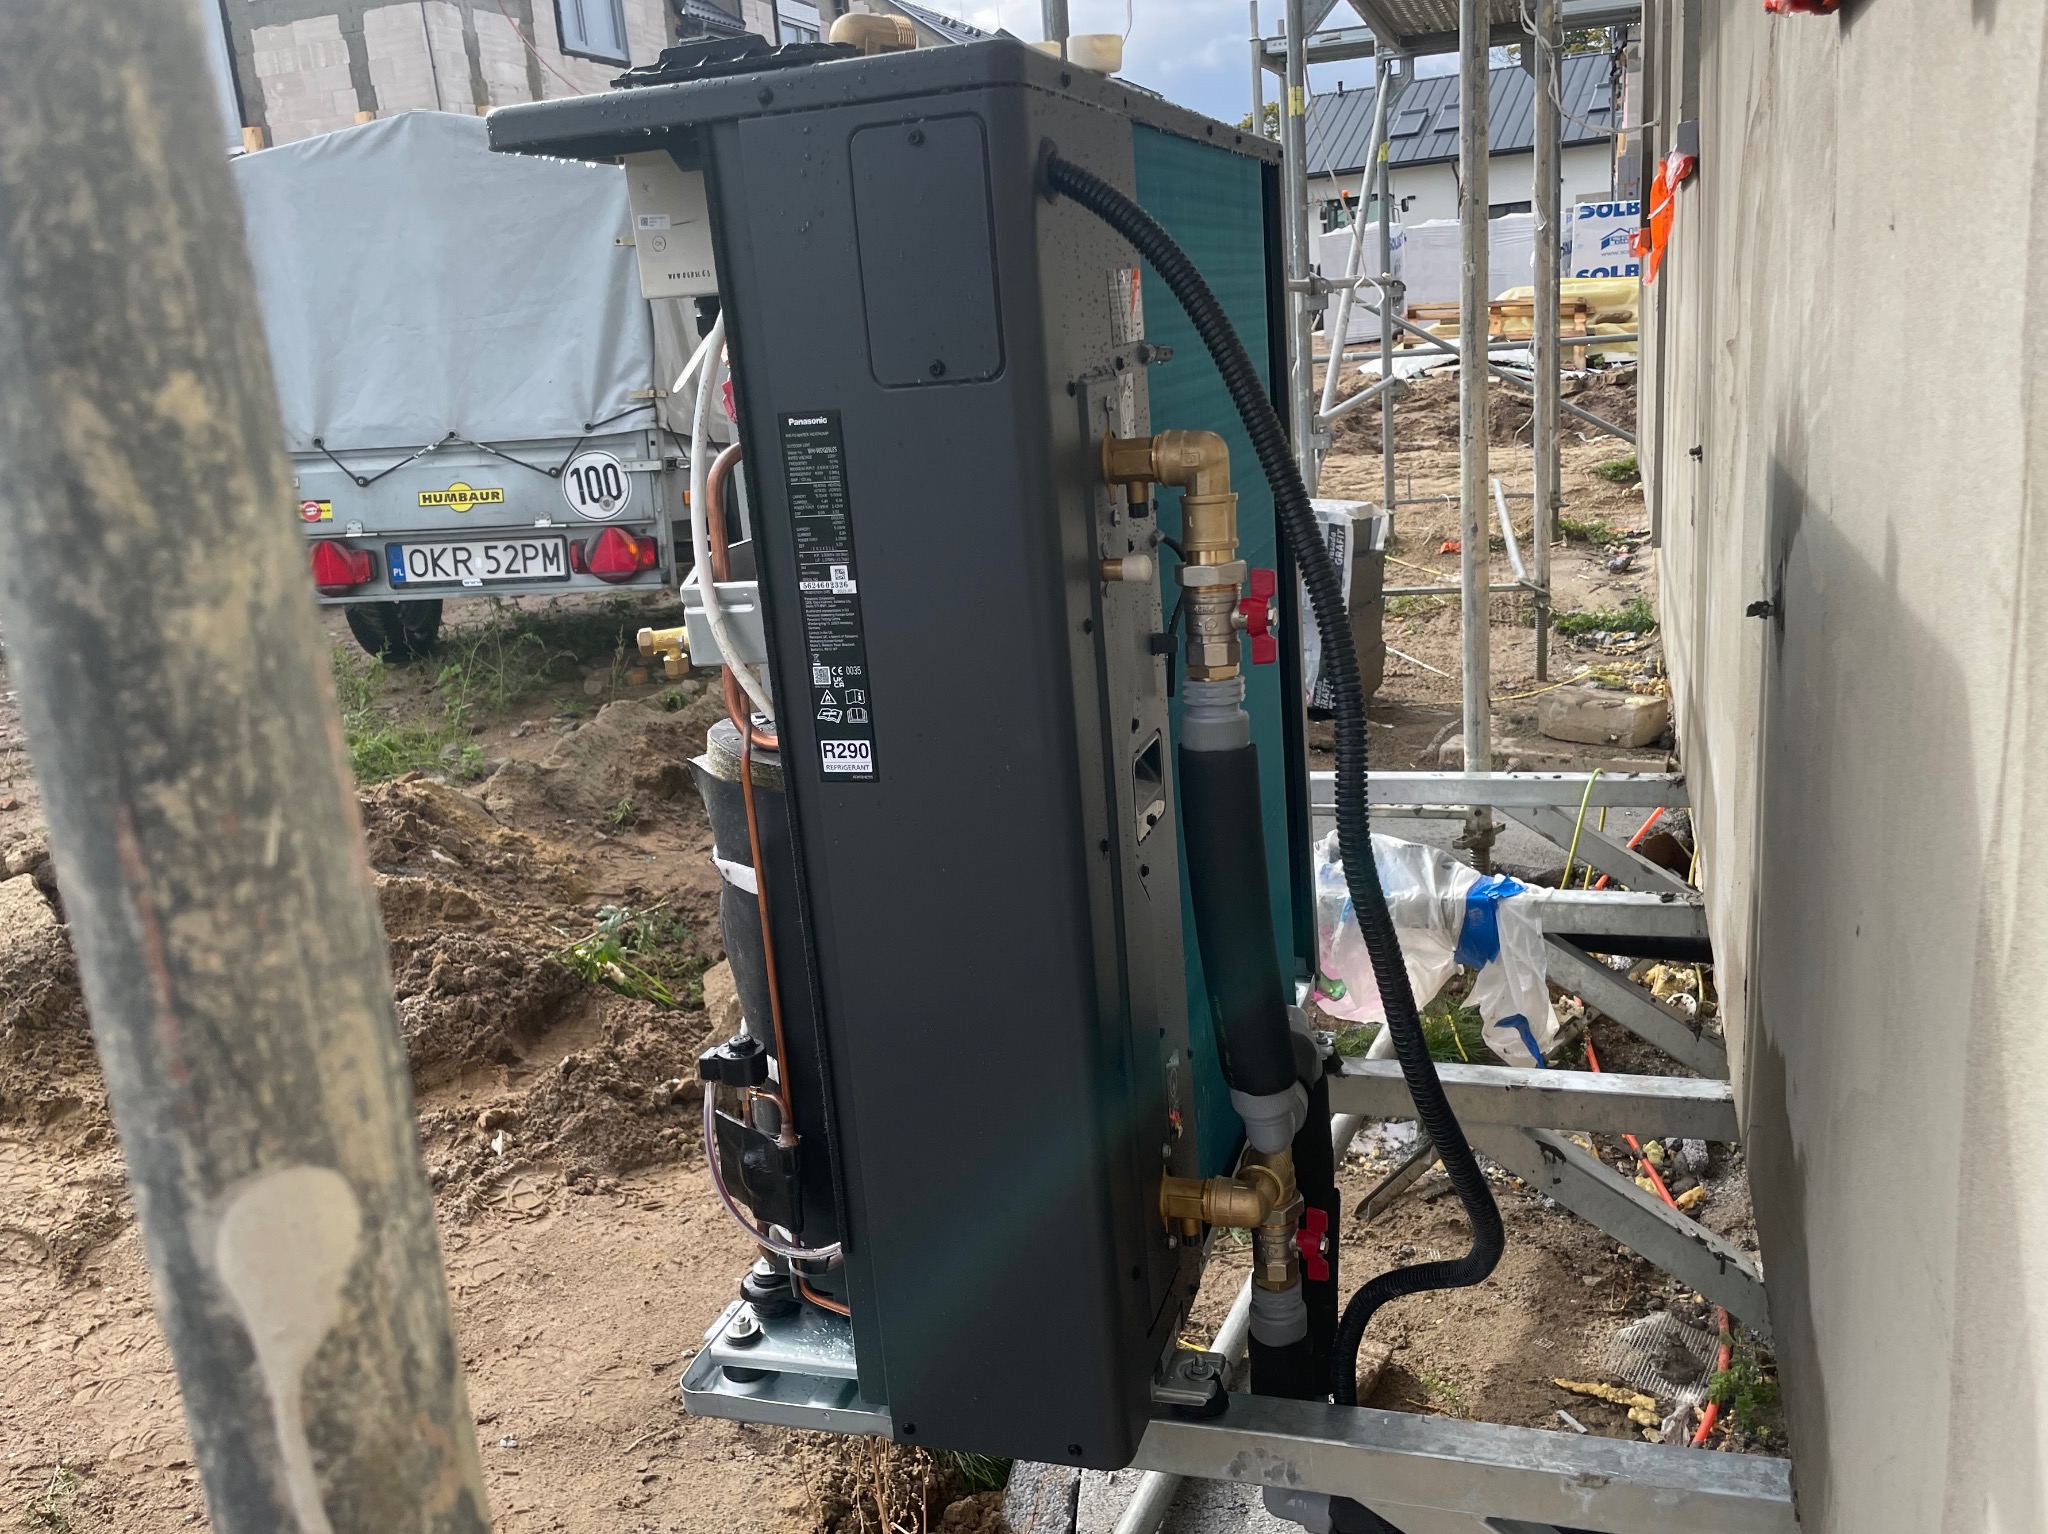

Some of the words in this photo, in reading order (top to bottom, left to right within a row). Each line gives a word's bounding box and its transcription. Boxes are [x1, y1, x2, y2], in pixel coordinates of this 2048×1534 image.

[1579, 203, 1640, 219] SOLB
[788, 416, 828, 426] Panasonic
[571, 463, 622, 505] 100
[422, 491, 501, 504] HUMBAUR
[1334, 528, 1345, 566] GRAFIT
[409, 547, 474, 578] OKR
[484, 542, 561, 575] 52PM
[393, 568, 404, 577] PL
[846, 666, 862, 675] 0035
[822, 742, 869, 759] R290
